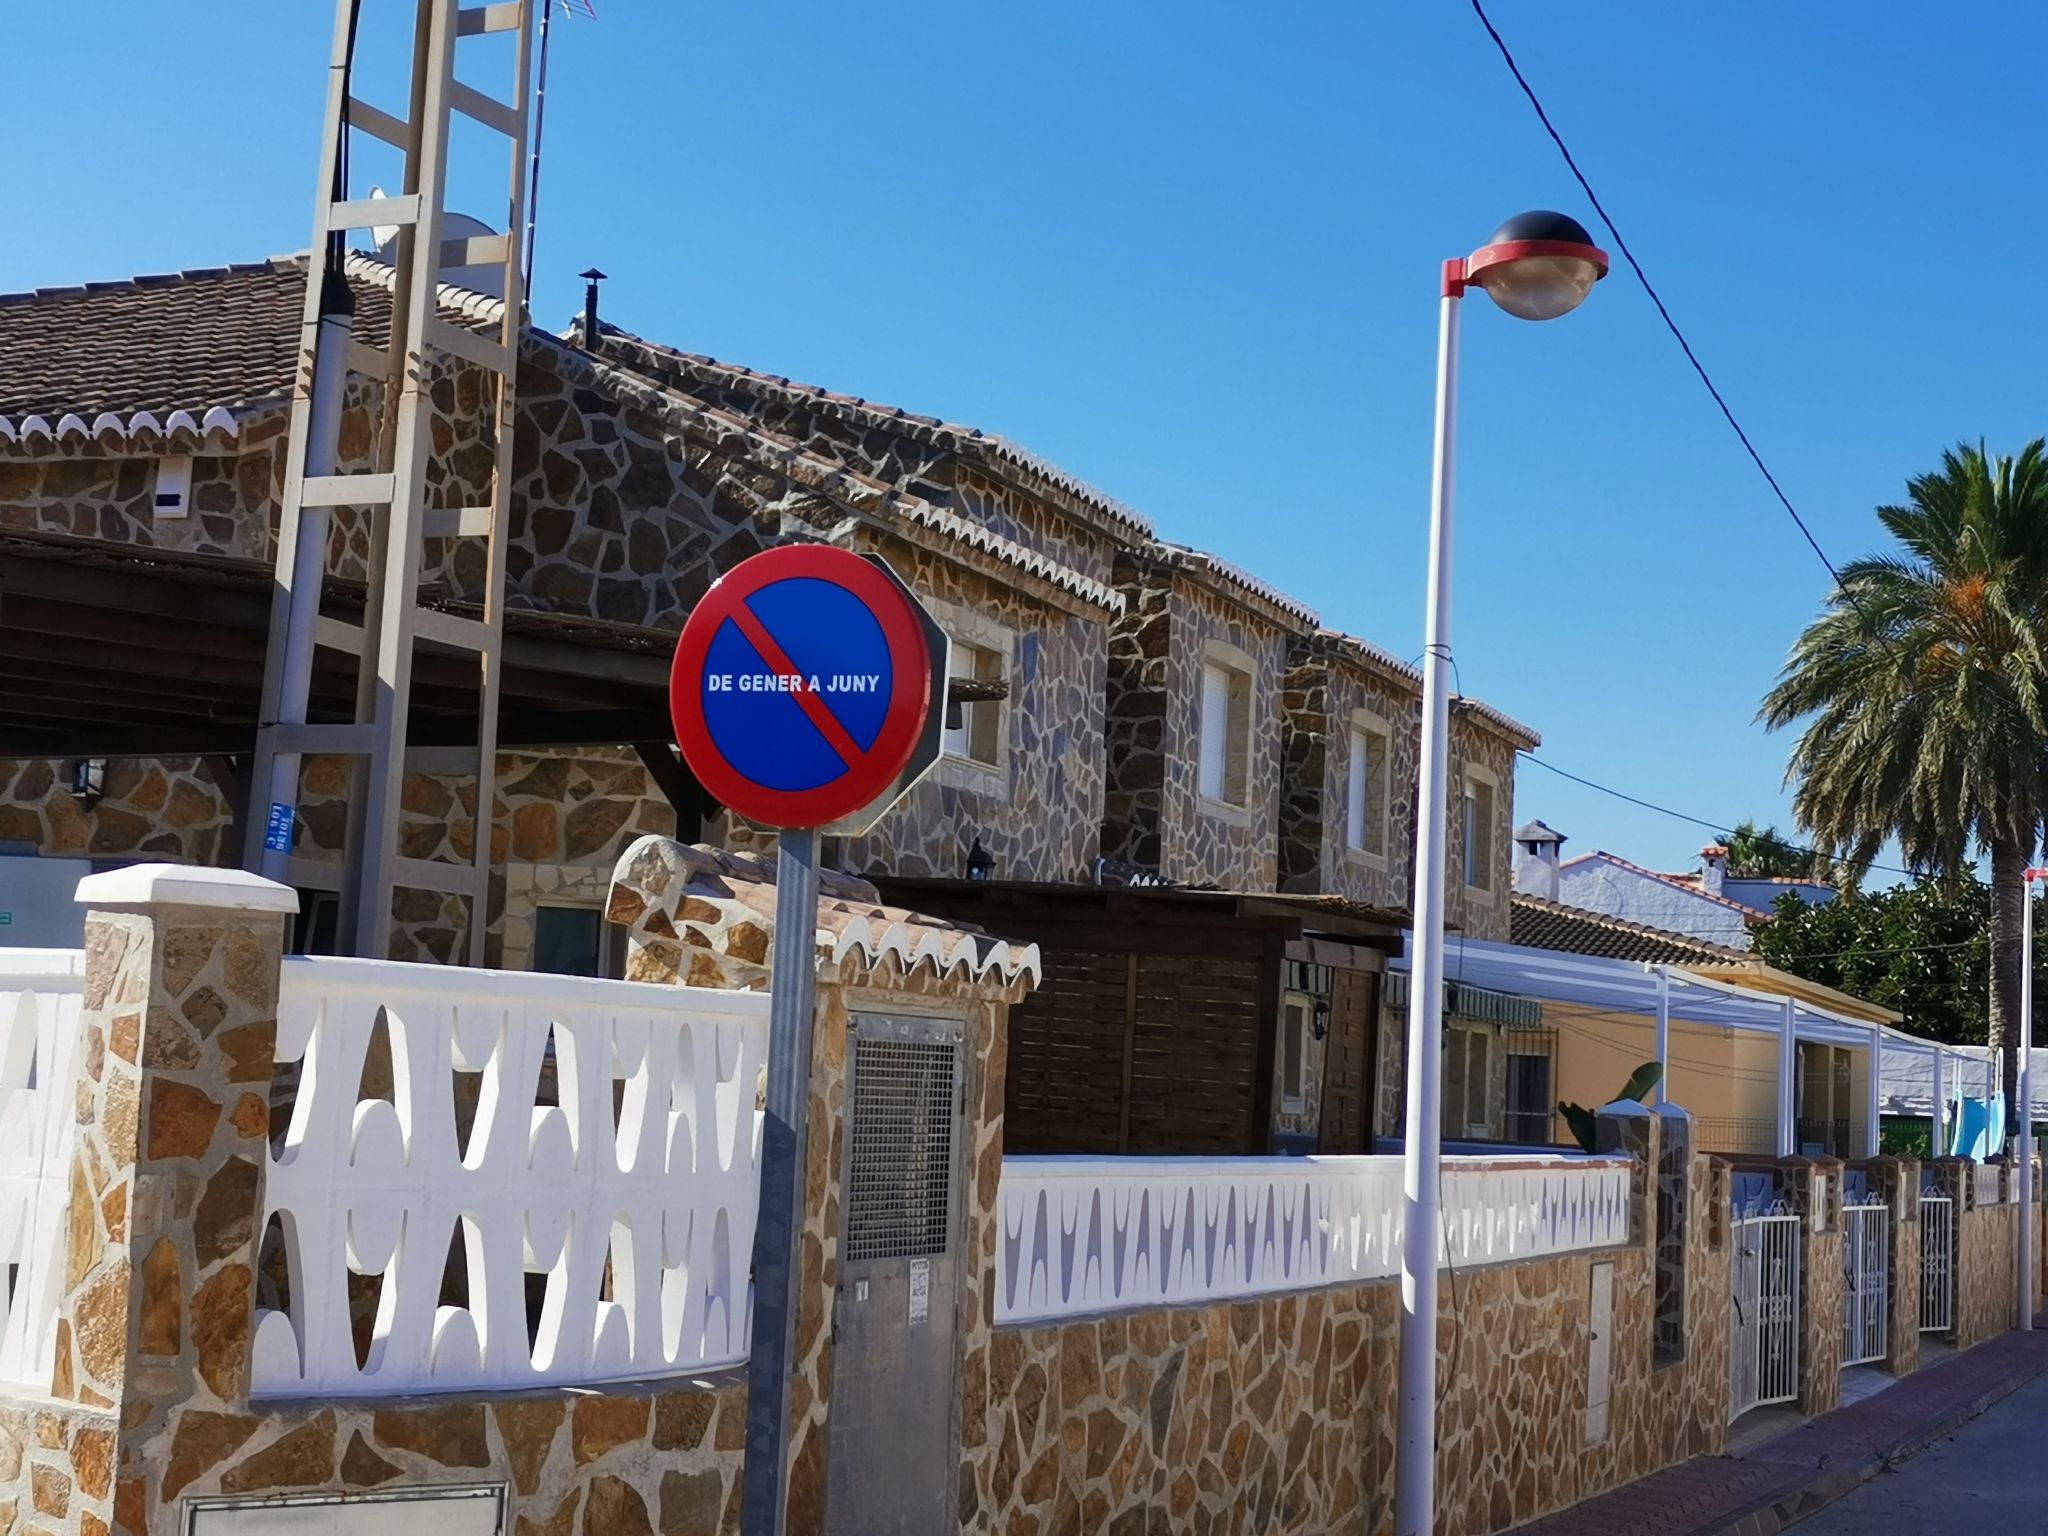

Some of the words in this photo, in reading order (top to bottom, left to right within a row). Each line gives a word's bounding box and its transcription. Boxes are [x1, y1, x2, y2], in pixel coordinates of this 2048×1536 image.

[708, 674, 732, 692] DE
[738, 674, 803, 692] GENER
[807, 674, 821, 692] A
[827, 674, 880, 693] JUNY
